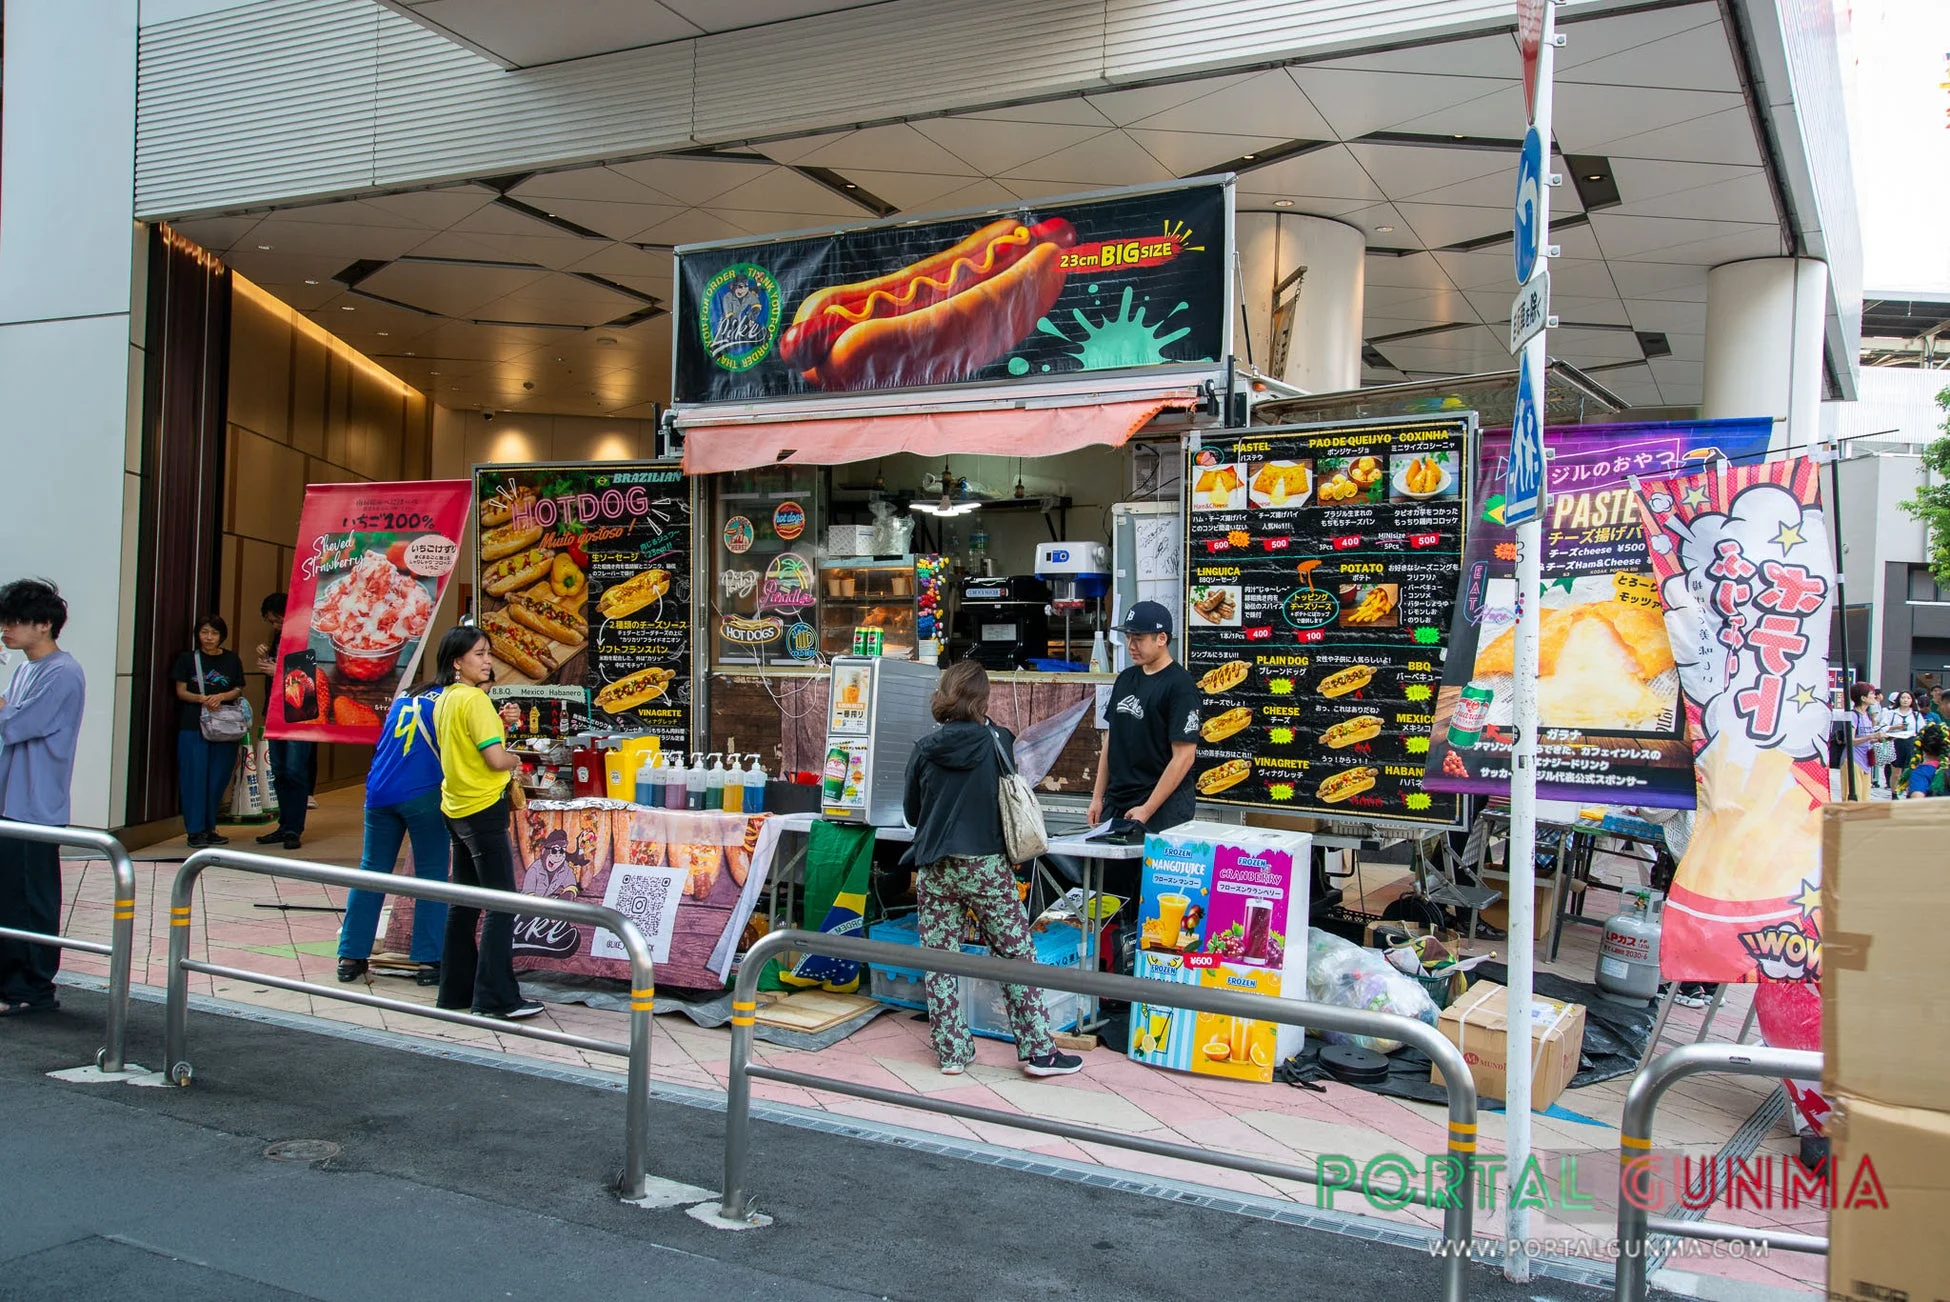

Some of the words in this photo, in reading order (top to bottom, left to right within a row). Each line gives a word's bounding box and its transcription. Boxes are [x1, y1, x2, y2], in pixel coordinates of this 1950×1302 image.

[1060, 254, 1099, 268] 23cm
[1101, 242, 1140, 267] BIG
[1141, 242, 1172, 258] SIZE
[706, 269, 736, 297] ORDER
[1399, 430, 1449, 441] COXINHA
[1233, 442, 1271, 453] PASTEL
[1309, 438, 1331, 449] PAO
[1332, 436, 1347, 447] DE
[1551, 451, 1676, 485] ジルのおやつ
[612, 471, 683, 484] BRAZILIAN
[511, 486, 649, 531] HOTDOG
[1323, 509, 1373, 517] ブラジル生まれの
[1552, 488, 1642, 530] PASTE
[343, 513, 435, 530] いちご100%
[536, 528, 574, 551] Muito
[577, 526, 624, 549] gostoso
[1418, 535, 1436, 545] 500
[1548, 526, 1642, 546] チーズ揚げパ
[1214, 541, 1229, 550] 600
[1271, 540, 1287, 549] 500
[1341, 537, 1359, 546] 400
[1617, 543, 1646, 553] ¥500
[591, 552, 639, 562] 生ソーセージ
[1197, 567, 1241, 576] LINGUICA
[1340, 563, 1384, 573] POTATO
[1468, 565, 1483, 611] EAT
[1294, 593, 1329, 601] トッピング
[726, 626, 746, 641] HOT
[746, 627, 775, 641] DOGS
[1252, 630, 1268, 638] 400
[1257, 655, 1286, 665] PLAIN
[1287, 656, 1310, 666] DOG
[1408, 661, 1431, 672] BBQ
[1396, 672, 1442, 680] バーベキュー
[521, 688, 545, 696] Mexico
[549, 689, 582, 697] Habanero
[638, 709, 682, 717] VINAGRETE
[1263, 706, 1301, 716] CHEESE
[1270, 716, 1291, 724] チーズ
[1402, 724, 1431, 732] メキシコ
[1547, 729, 1582, 741] ガラナ
[1254, 757, 1310, 769] VINAGRETE
[1385, 765, 1425, 777] HABAN
[1400, 778, 1423, 788] ハバネ
[1164, 848, 1192, 858] FROZEN
[1238, 857, 1267, 867] FROZEN
[1219, 869, 1282, 885] CRANBERRY
[1190, 956, 1213, 966] ¥600
[1151, 965, 1177, 974] FROZEN
[1227, 977, 1257, 987] FROZEN
